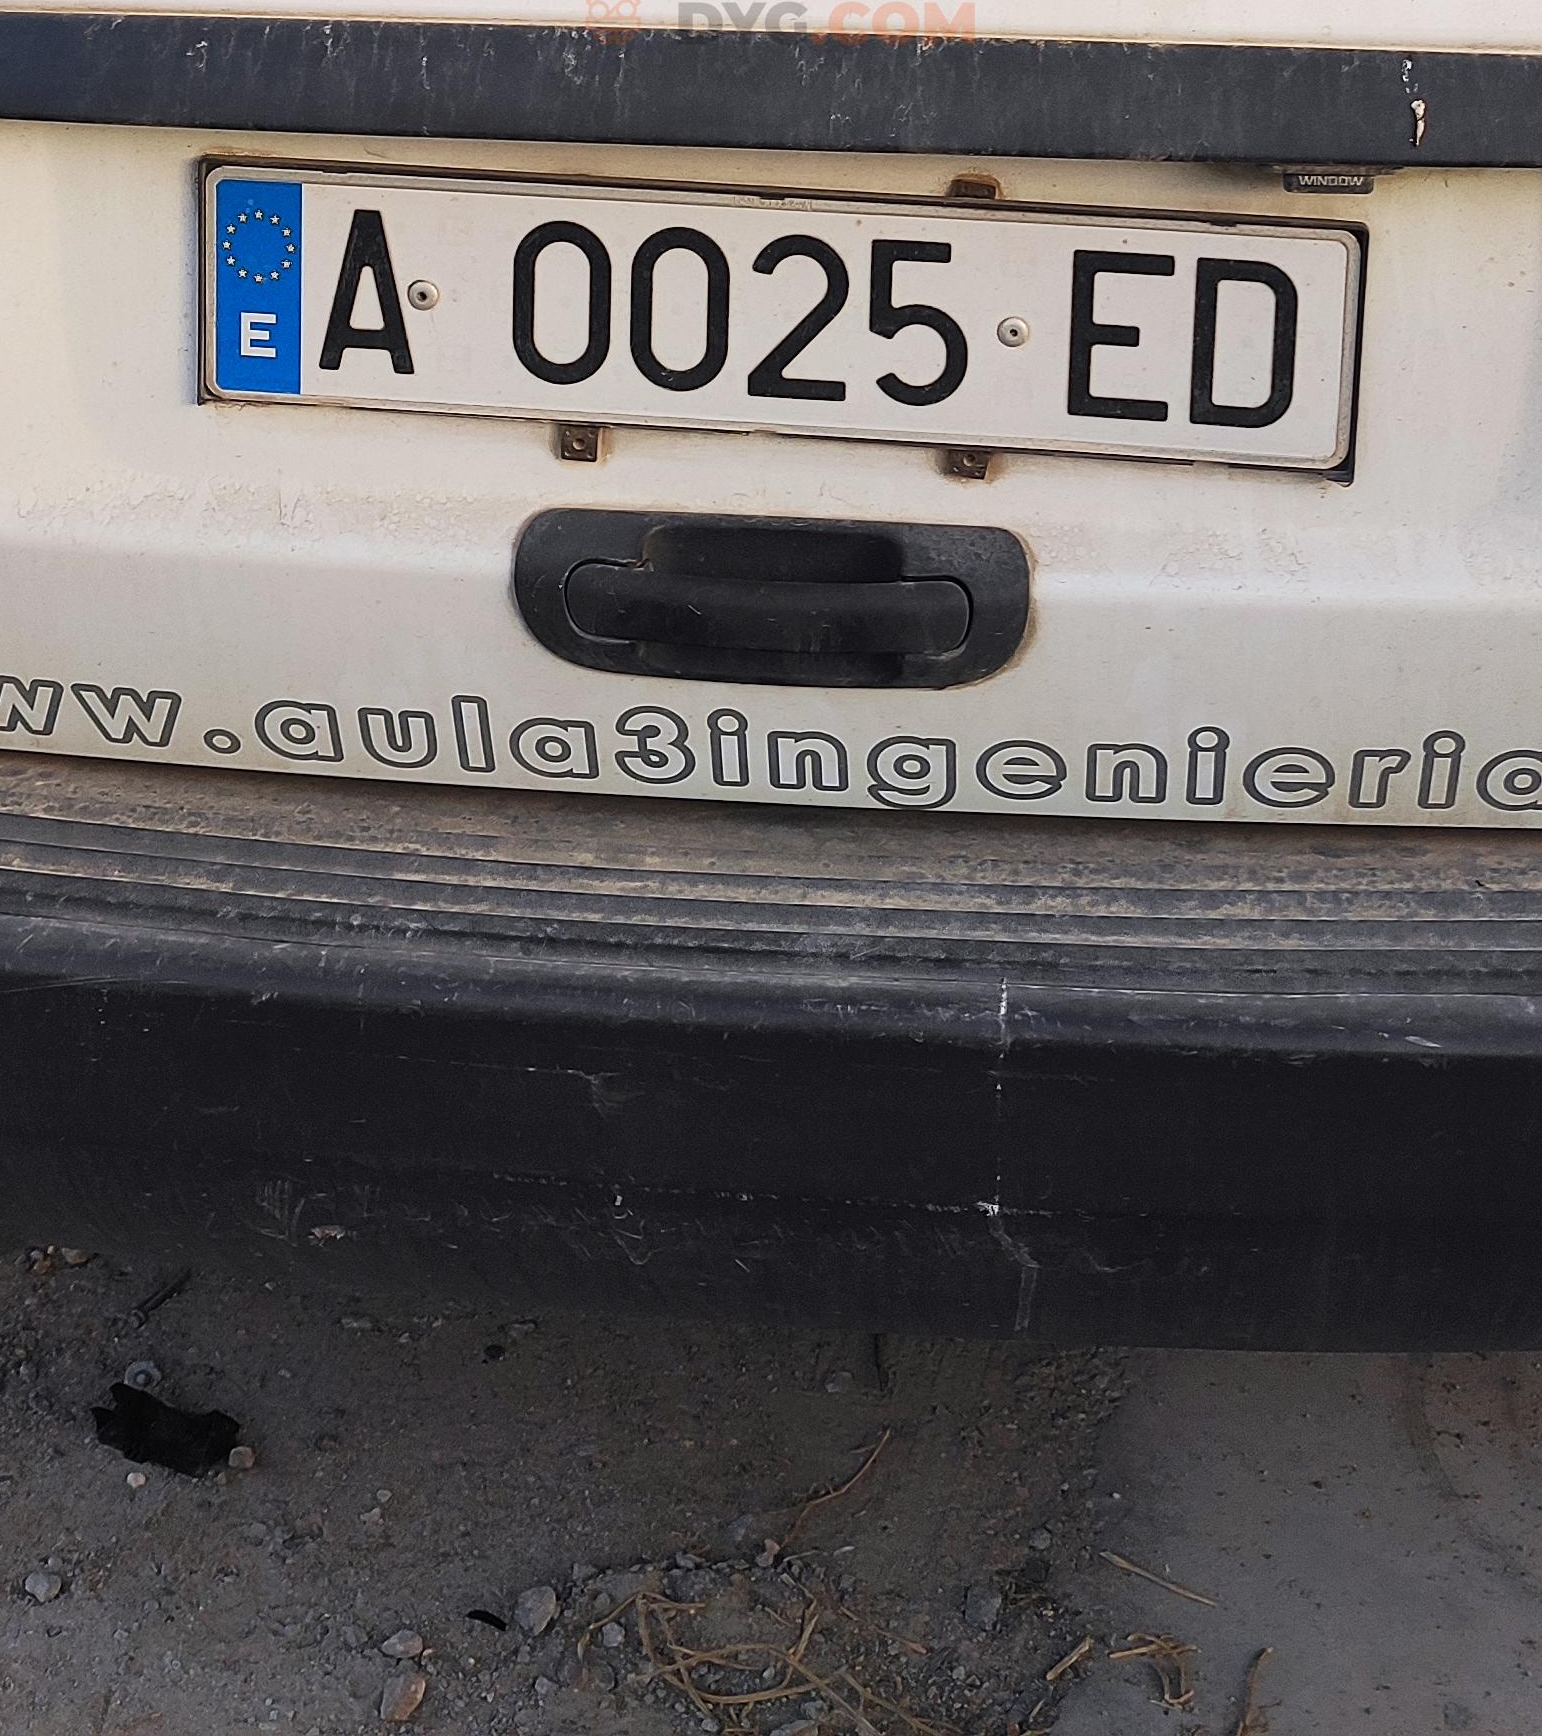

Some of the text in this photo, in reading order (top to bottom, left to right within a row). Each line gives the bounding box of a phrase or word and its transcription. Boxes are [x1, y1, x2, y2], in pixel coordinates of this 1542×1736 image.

[1298, 175, 1363, 187] WINDOW
[239, 312, 277, 359] E
[319, 209, 1300, 428] A 0025 ED
